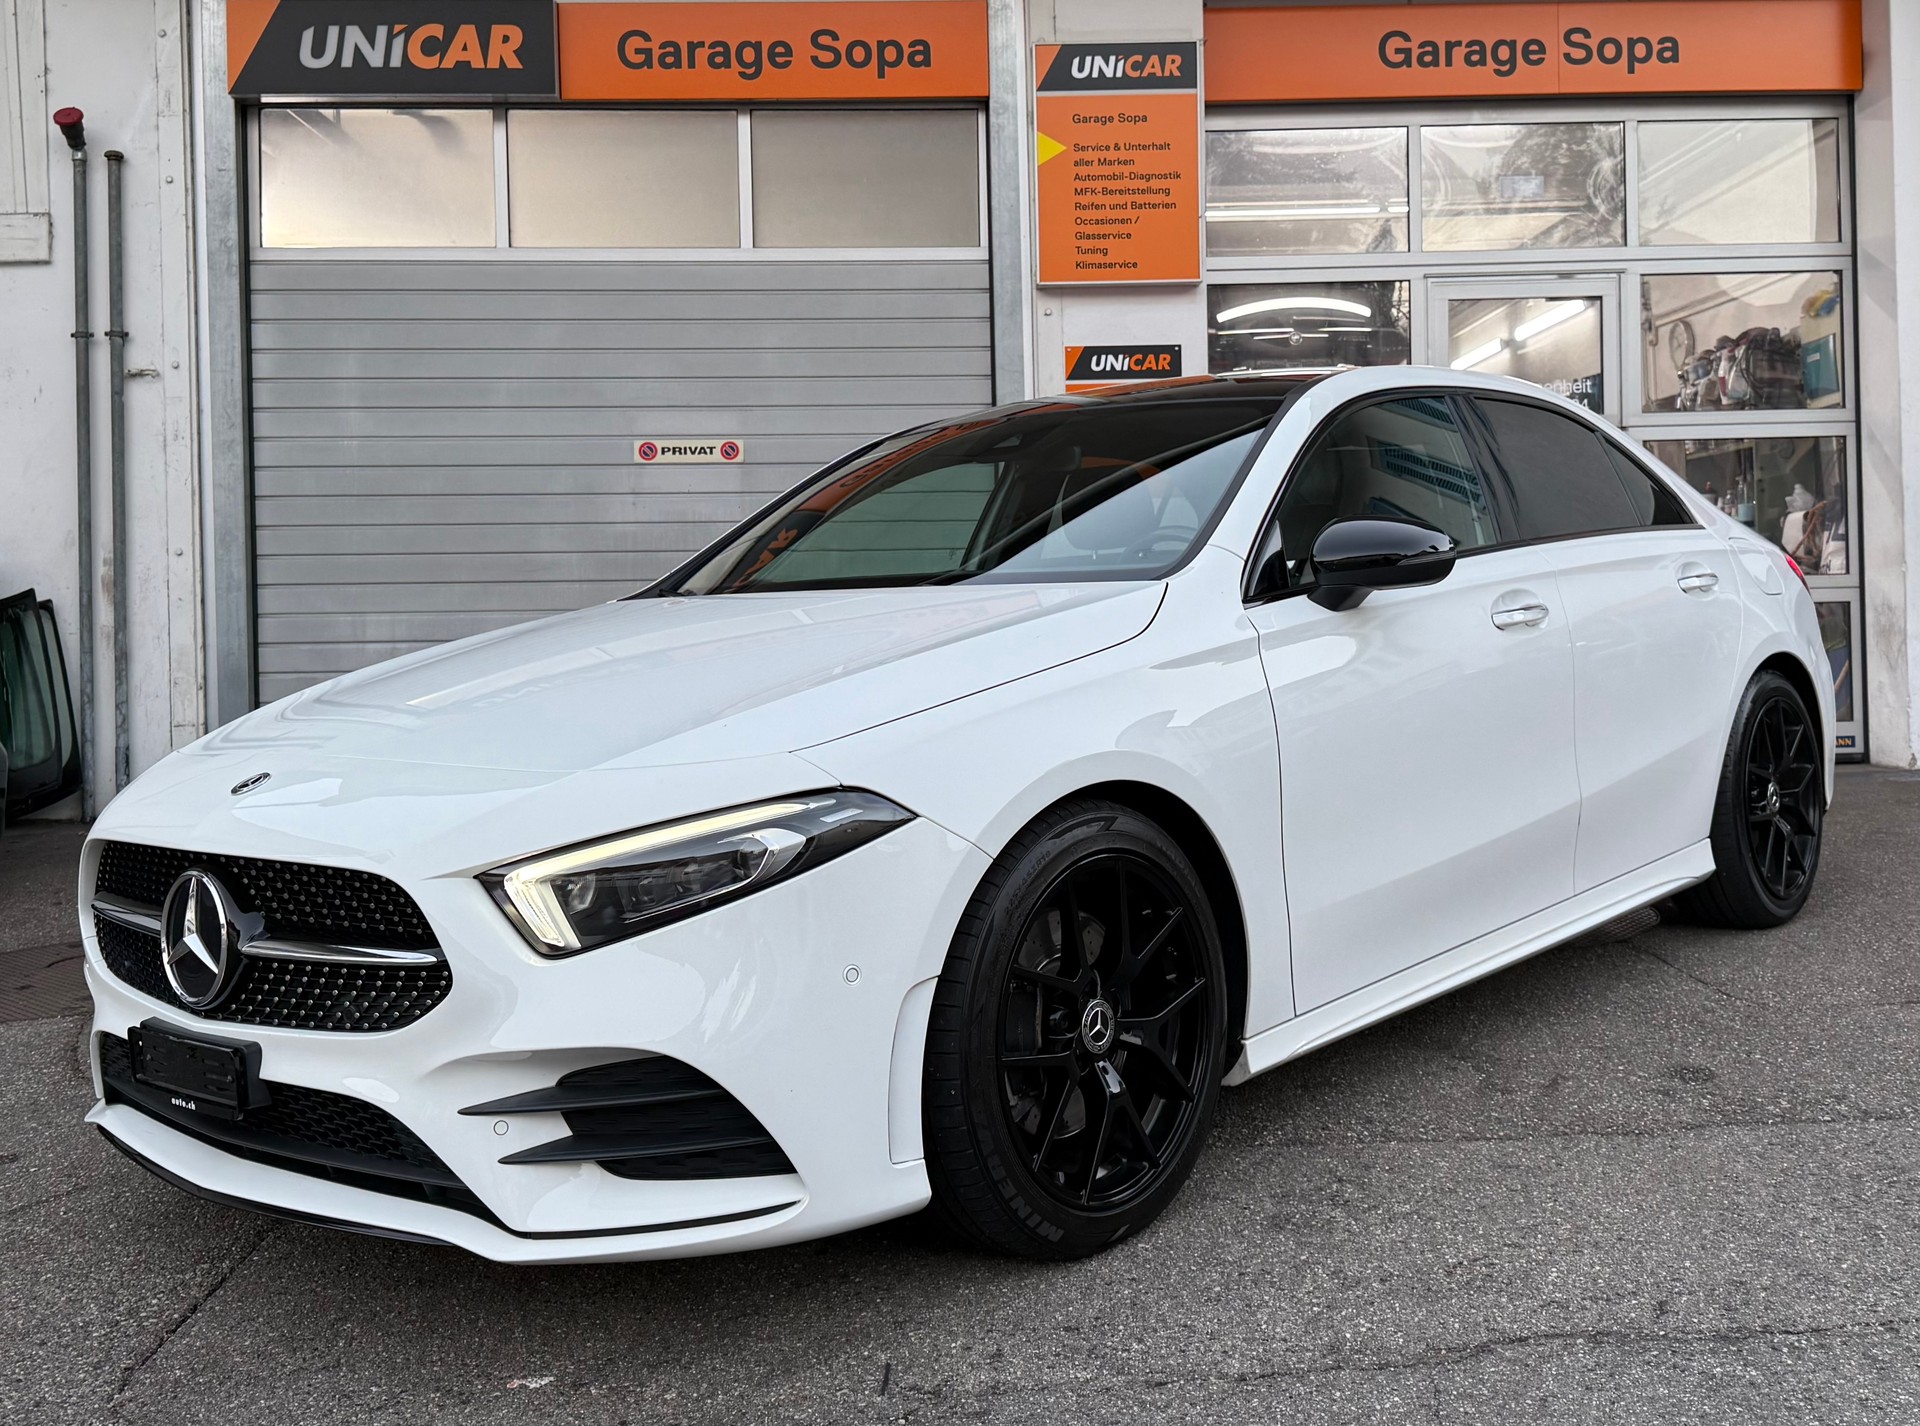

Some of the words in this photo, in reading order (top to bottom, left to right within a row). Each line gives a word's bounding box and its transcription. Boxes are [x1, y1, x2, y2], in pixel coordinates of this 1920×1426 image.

[617, 29, 794, 81] Garage
[809, 28, 932, 79] Sopa
[1378, 30, 1547, 77] Garage
[1562, 27, 1680, 75] Sopa
[1072, 113, 1115, 126] Garage
[1117, 112, 1148, 125] Sopa
[1073, 143, 1111, 152] Service
[1113, 143, 1121, 151] &
[1123, 142, 1171, 151] Unterhalt
[1073, 158, 1094, 167] aller
[1098, 157, 1135, 166] Marken
[1073, 171, 1182, 182] Automobil-Diagnostik
[1074, 186, 1171, 197] MFK-Bereitstellung
[1074, 202, 1107, 211] Reifen
[1109, 201, 1128, 210] und
[1130, 200, 1177, 210] Batterien
[1074, 216, 1132, 226] Occasionen
[1075, 231, 1132, 240] Glasservice
[1075, 246, 1108, 256] Tuning
[1075, 260, 1138, 270] Klimaservice
[1541, 378, 1592, 394] enheit
[660, 446, 716, 456] PRIVAT
